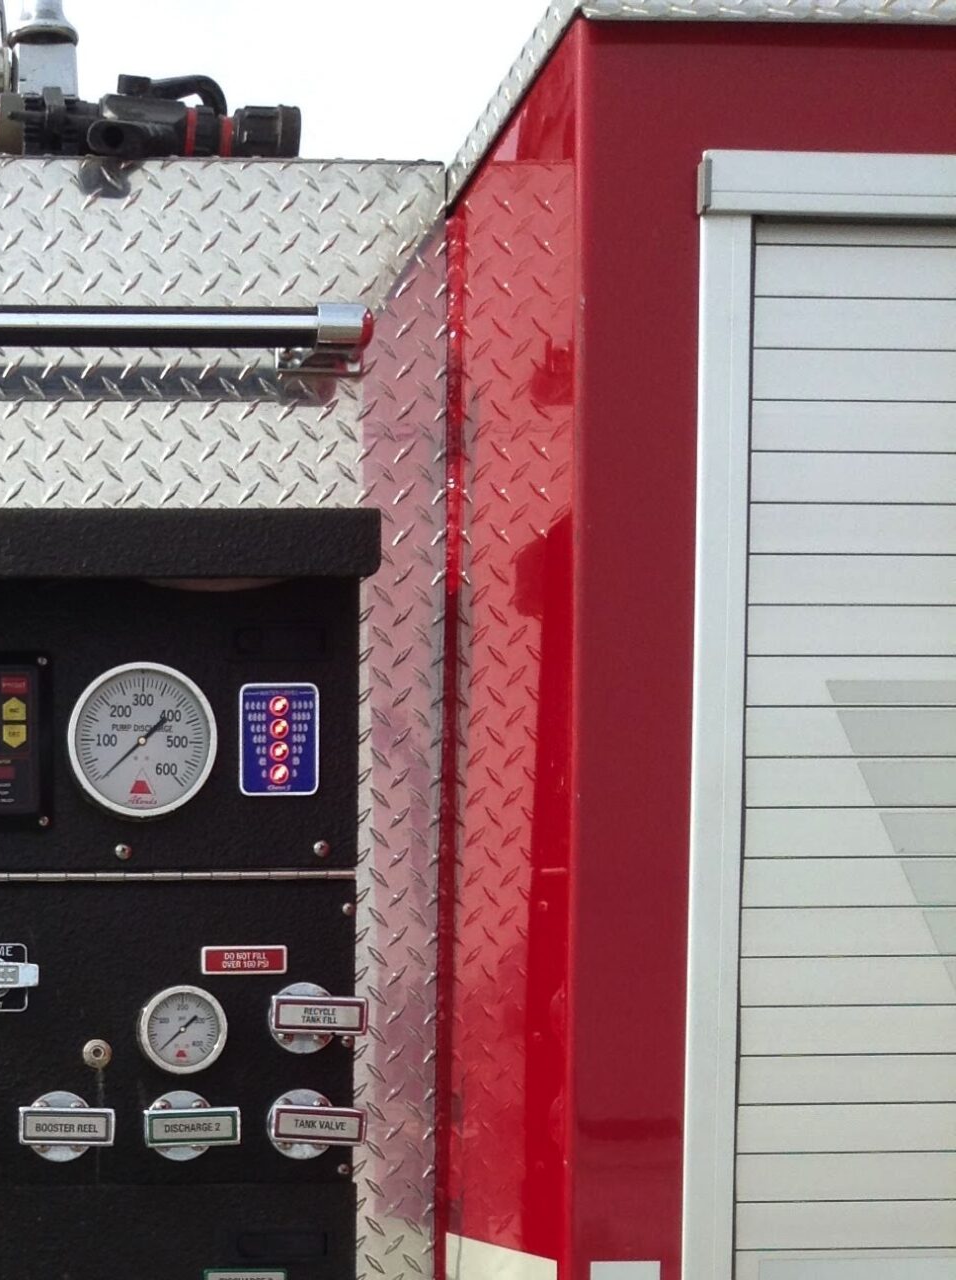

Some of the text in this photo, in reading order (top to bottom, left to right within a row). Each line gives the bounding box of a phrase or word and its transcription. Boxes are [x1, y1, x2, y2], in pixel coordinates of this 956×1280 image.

[132, 694, 154, 706] 300
[110, 705, 132, 718] 200
[160, 710, 181, 722] 400
[96, 734, 118, 747] 100
[167, 736, 188, 748] 500
[156, 763, 178, 776] 600
[304, 1007, 336, 1016] RECYCLE
[301, 1016, 338, 1024] TANK FILL
[35, 1123, 98, 1134] BOOSTER REEL
[164, 1123, 220, 1133] DISCHARGE 2
[294, 1119, 346, 1131] TANK VALVE
